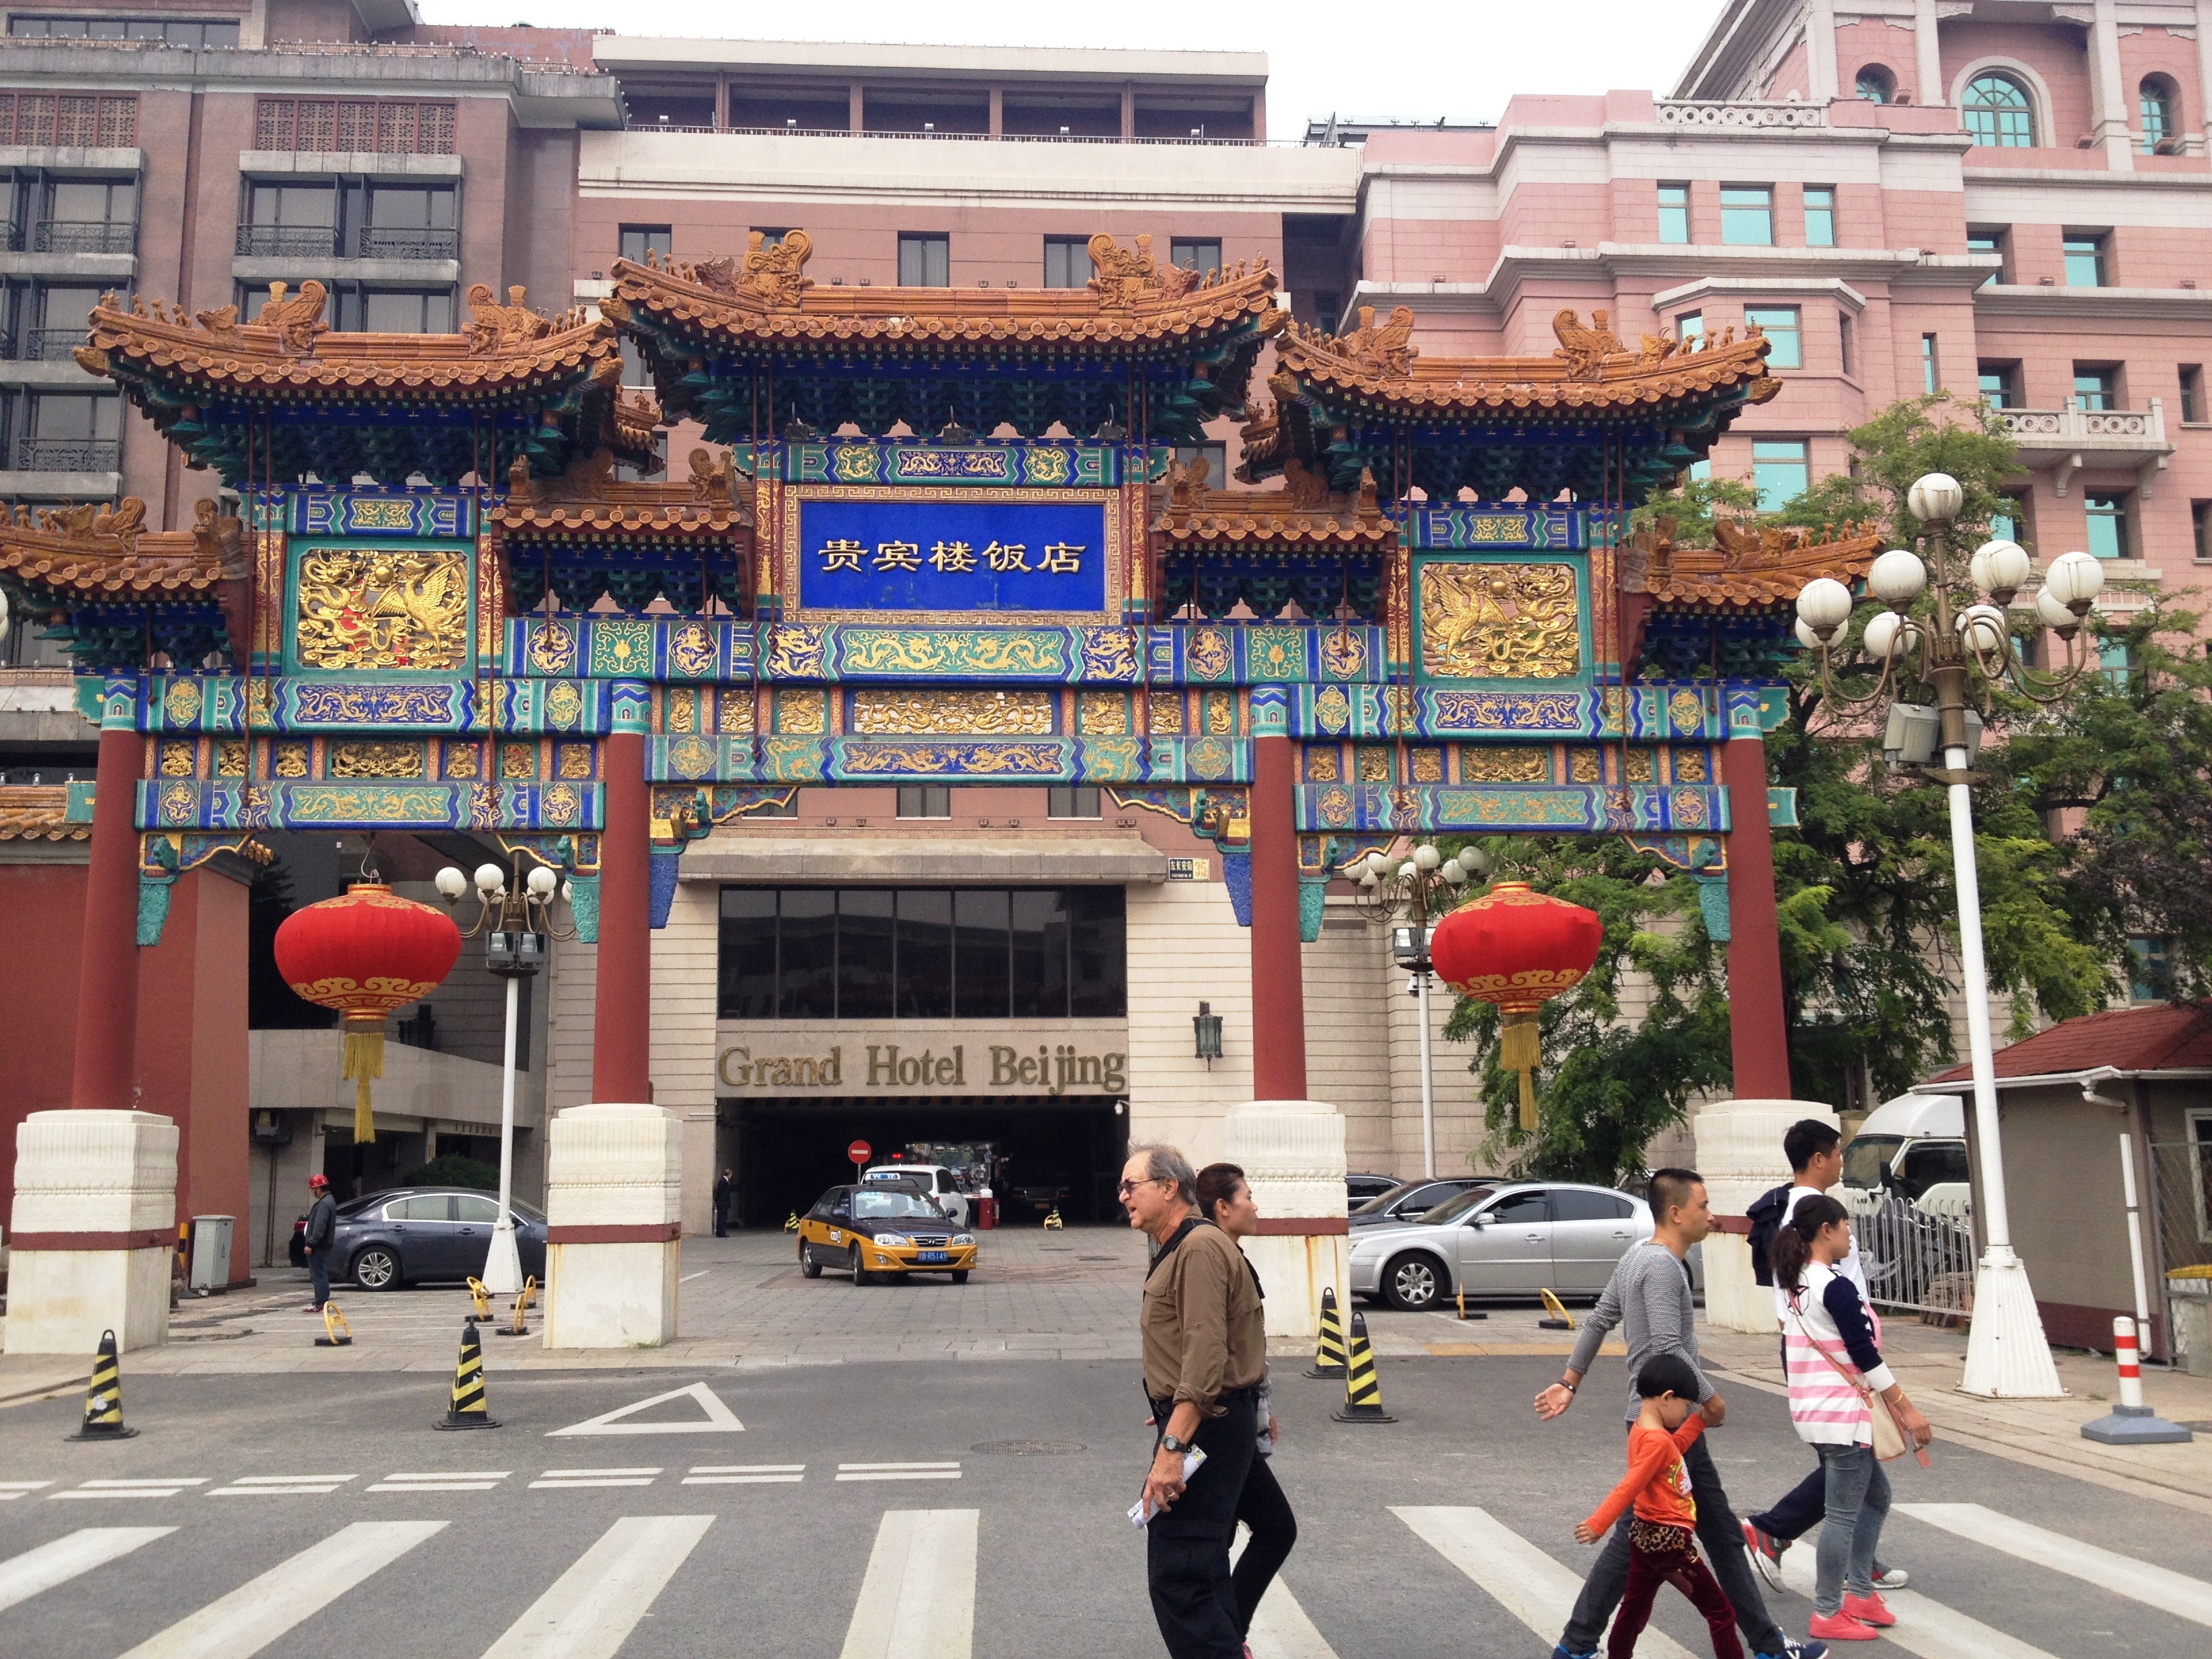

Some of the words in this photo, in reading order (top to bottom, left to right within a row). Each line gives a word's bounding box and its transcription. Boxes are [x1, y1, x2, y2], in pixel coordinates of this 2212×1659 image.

[817, 539, 1086, 574] 贵宾楼饭店
[1195, 861, 1206, 877] 35
[718, 1046, 843, 1086] Grand
[866, 1044, 966, 1086] Hotel
[988, 1044, 1127, 1095] Beijing
